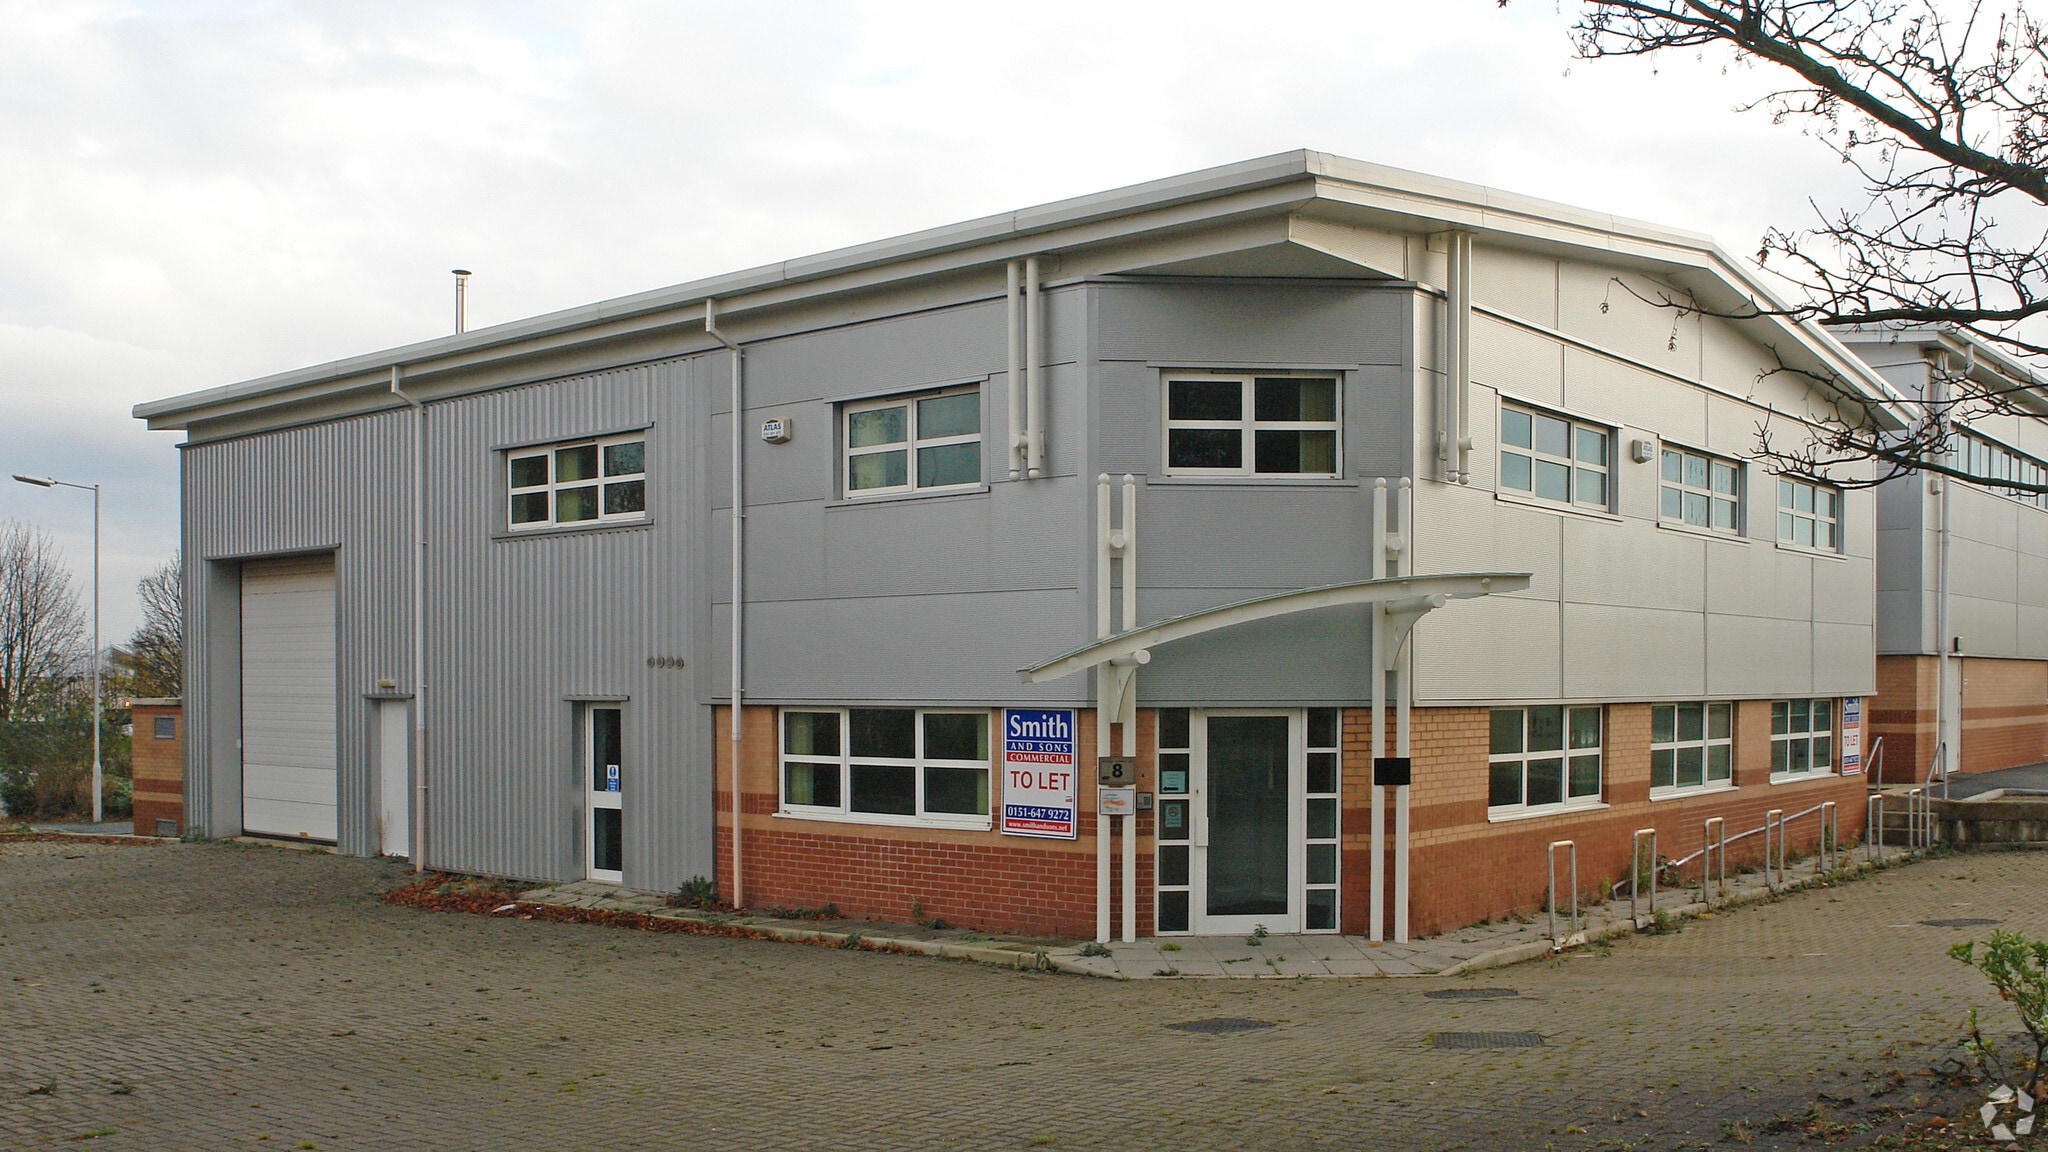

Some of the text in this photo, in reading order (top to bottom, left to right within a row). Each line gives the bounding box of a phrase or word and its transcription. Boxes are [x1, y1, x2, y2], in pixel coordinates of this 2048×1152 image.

[763, 422, 782, 431] ATLAS
[1010, 714, 1068, 738] Smith
[1010, 742, 1068, 752] AND SONS
[1010, 753, 1070, 763] COMMERCIAL
[1112, 763, 1123, 778] 8
[1010, 770, 1070, 791] TO LET
[1007, 806, 1069, 820] 0151-647 9272
